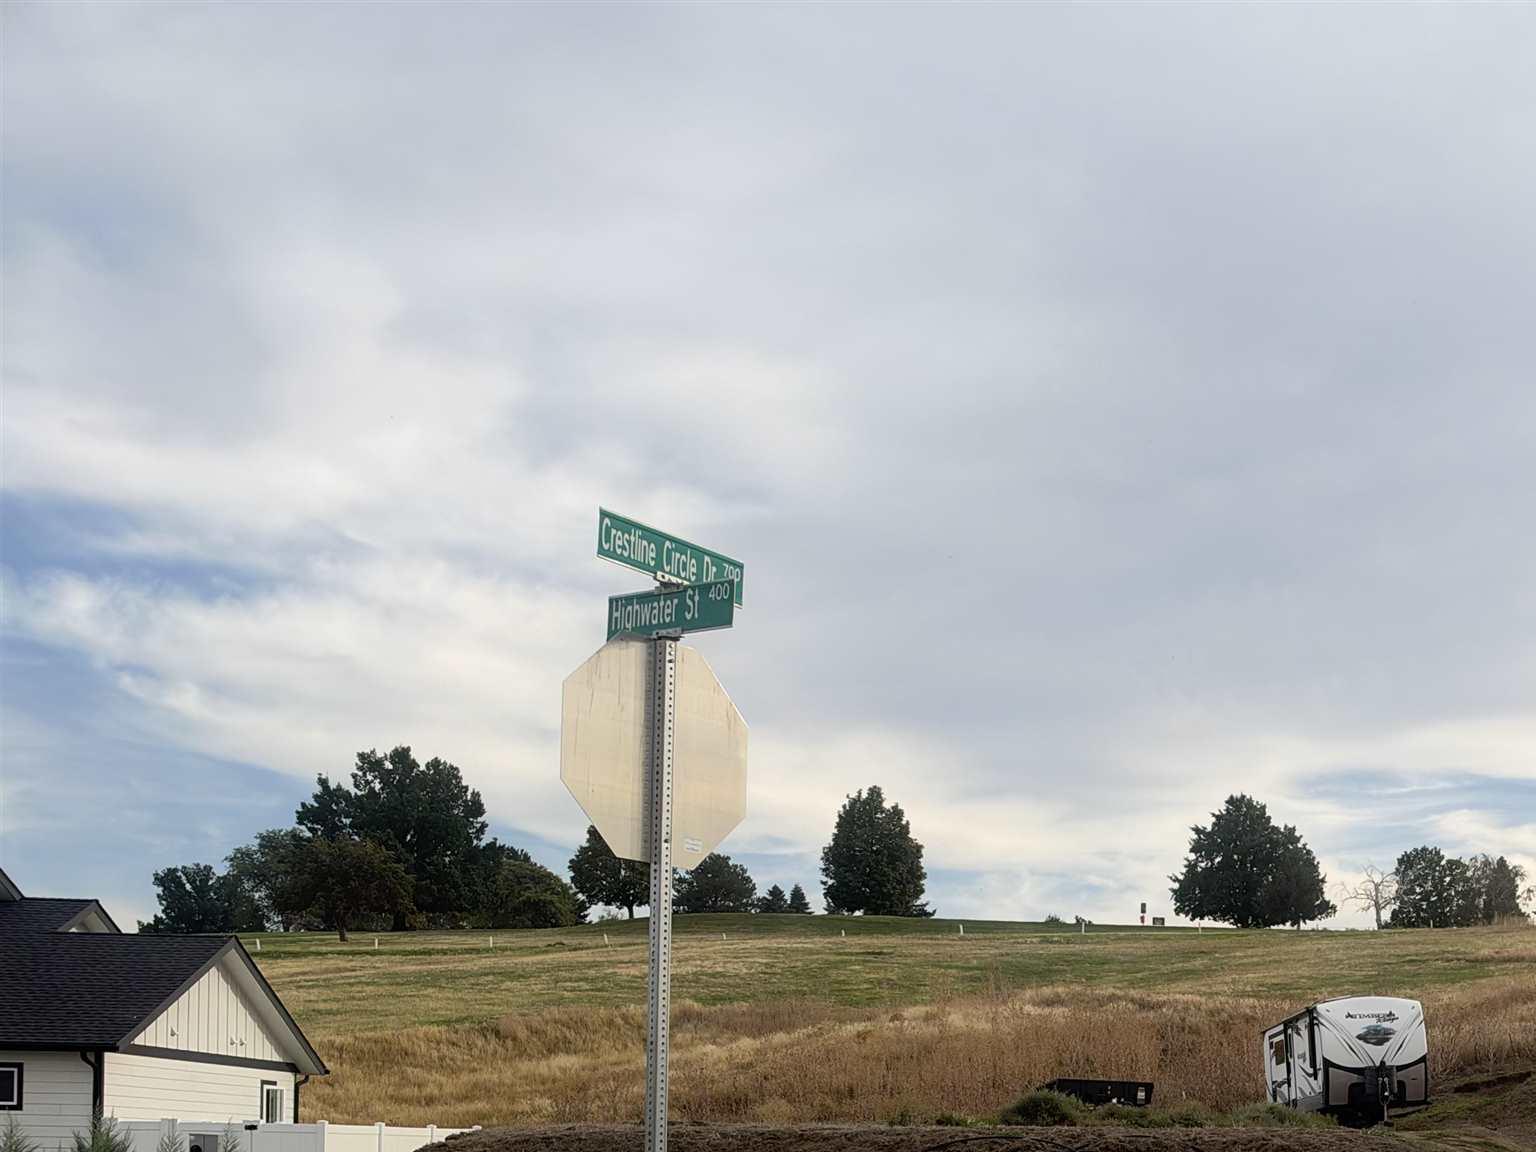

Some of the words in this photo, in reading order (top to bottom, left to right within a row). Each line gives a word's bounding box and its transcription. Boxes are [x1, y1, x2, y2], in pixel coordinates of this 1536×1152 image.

[602, 518, 656, 566] Crestline
[663, 540, 697, 582] Circle
[703, 555, 717, 583] Dr
[722, 563, 741, 582] 700
[611, 595, 679, 632] Highwater
[684, 587, 700, 620] St
[709, 583, 730, 600] 400
